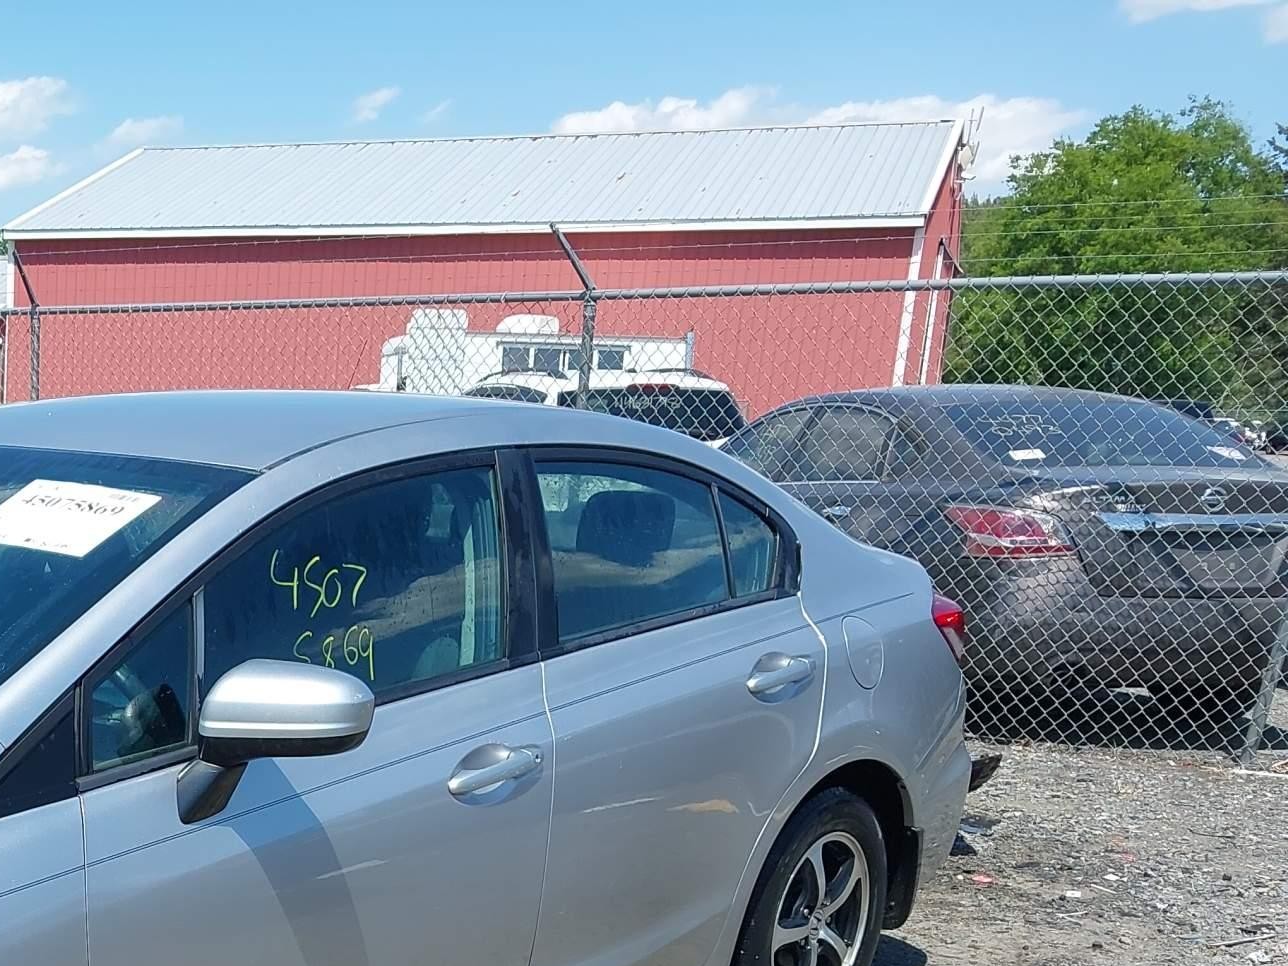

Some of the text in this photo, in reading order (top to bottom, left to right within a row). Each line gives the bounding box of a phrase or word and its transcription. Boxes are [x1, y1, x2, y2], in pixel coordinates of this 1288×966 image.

[22, 494, 125, 516] 45075869
[1080, 495, 1134, 504] ALTMA
[270, 548, 368, 618] 4507
[292, 624, 376, 681] 5869
